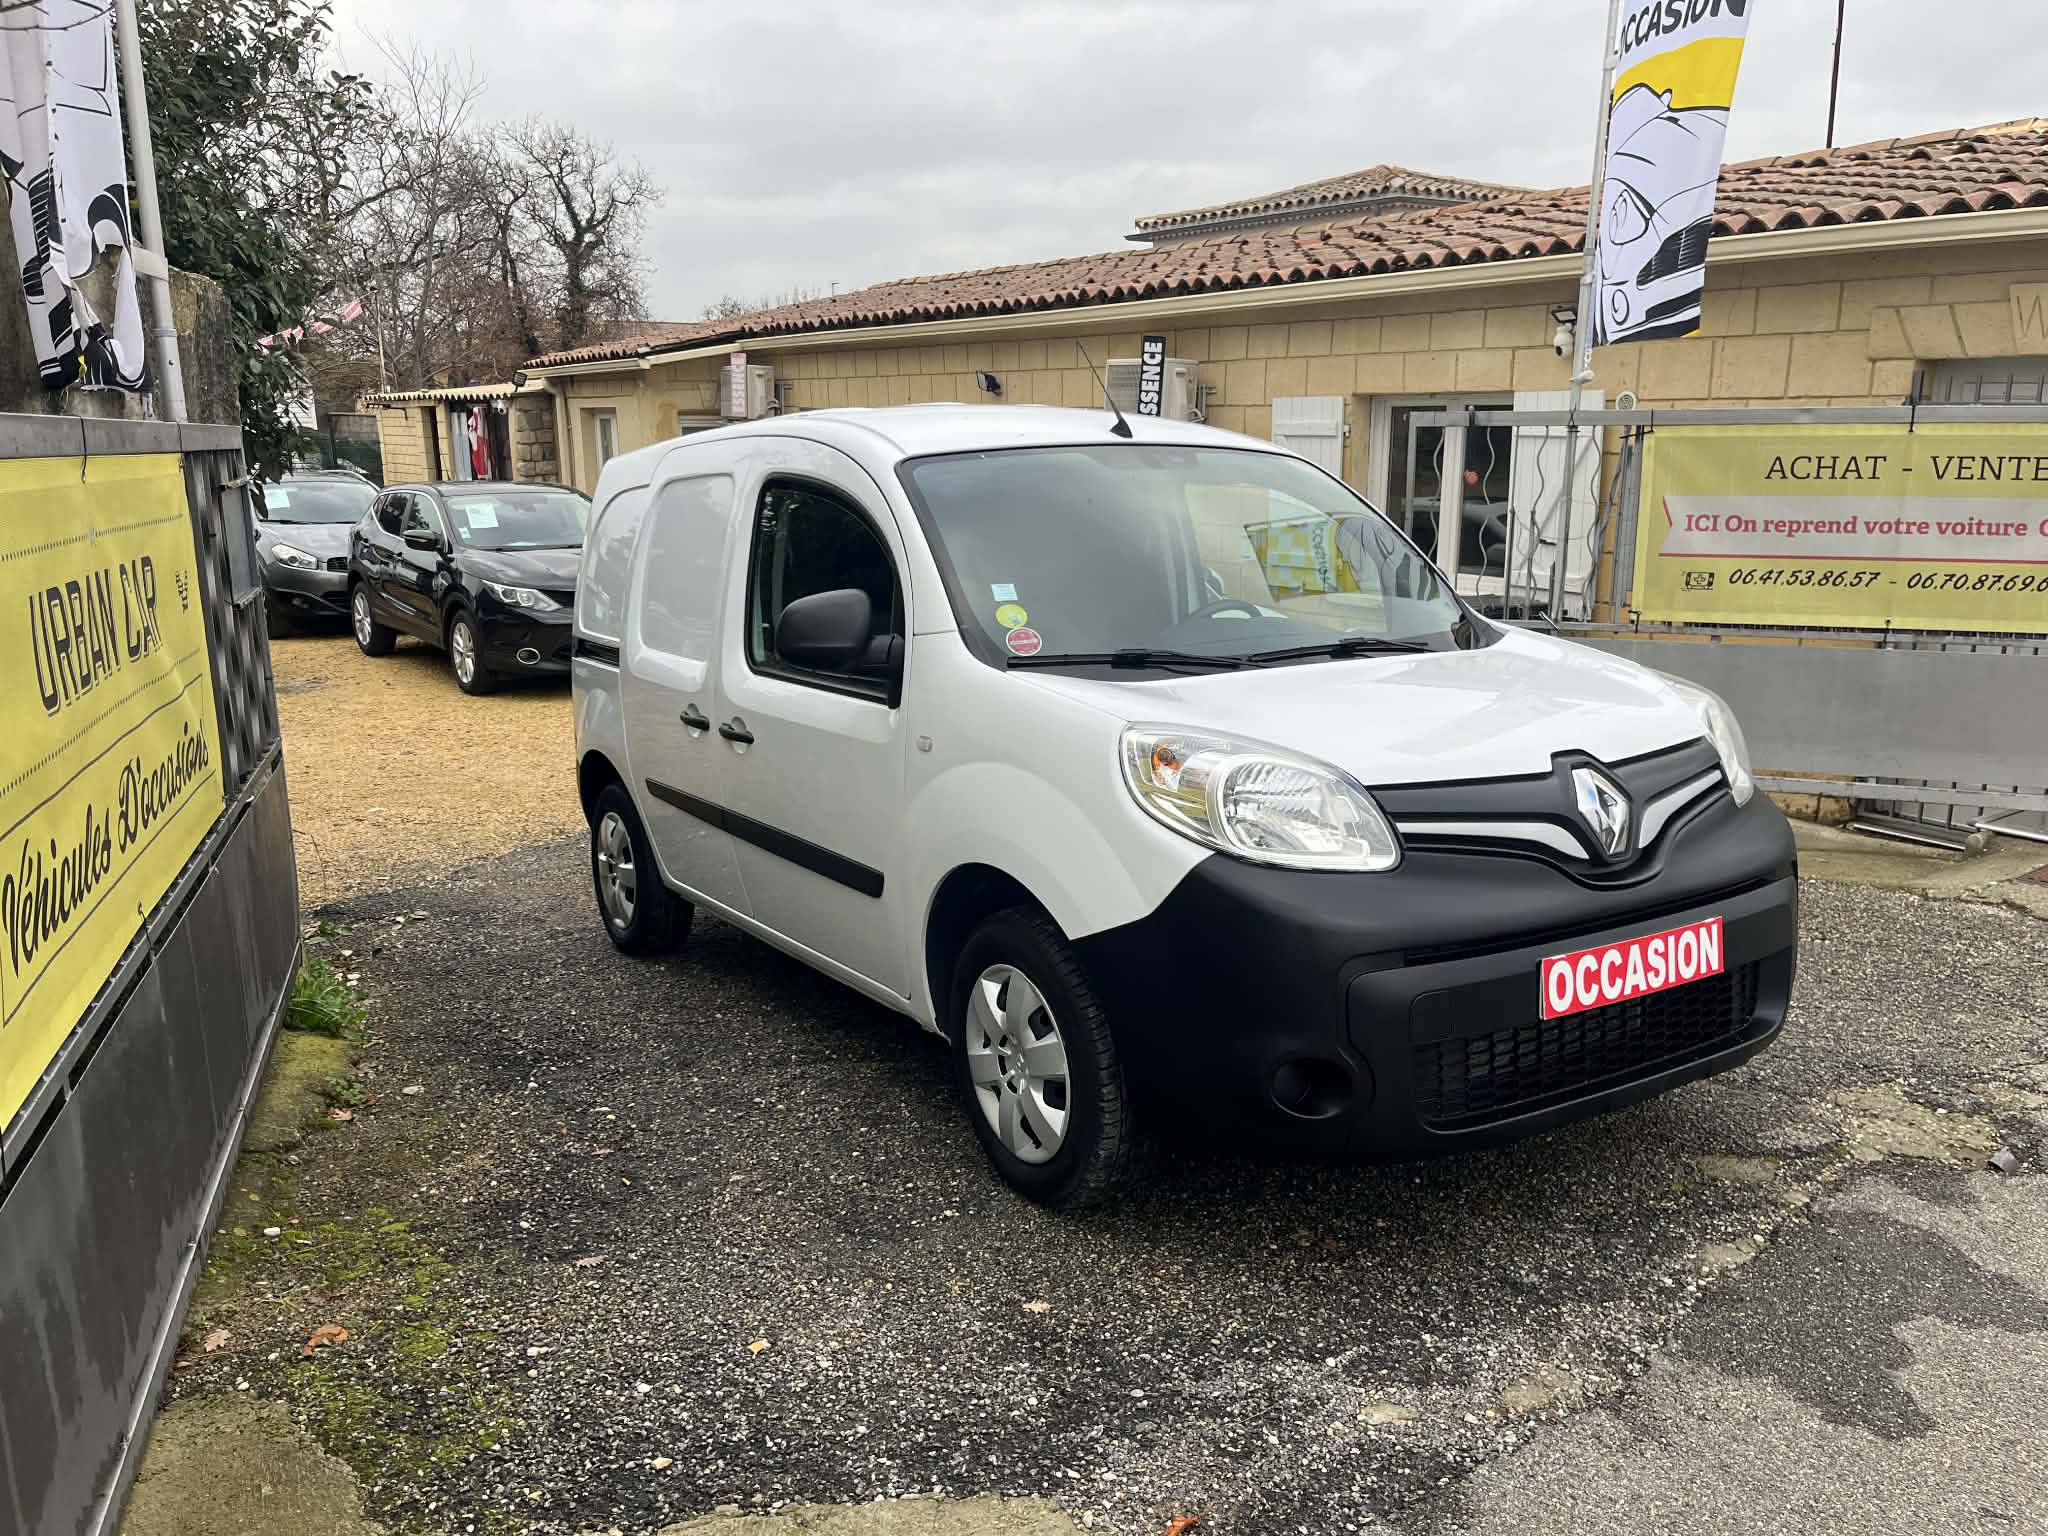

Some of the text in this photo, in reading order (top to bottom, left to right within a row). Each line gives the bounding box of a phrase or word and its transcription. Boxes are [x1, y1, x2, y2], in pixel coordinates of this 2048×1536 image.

[1764, 456, 1887, 480] ACHAT
[1930, 456, 2048, 481] VENTE
[1684, 514, 1720, 532] ICI
[1725, 514, 1757, 533] On
[1763, 515, 1858, 538] reprend
[1864, 517, 1930, 535] votre
[1936, 516, 2029, 537] voiture
[1728, 568, 1881, 588] 06.41.53.86.57
[29, 556, 163, 717] URBAN CAR
[2, 718, 209, 979] Véhicules D'occasions
[1548, 923, 1720, 1013] OCCASION
